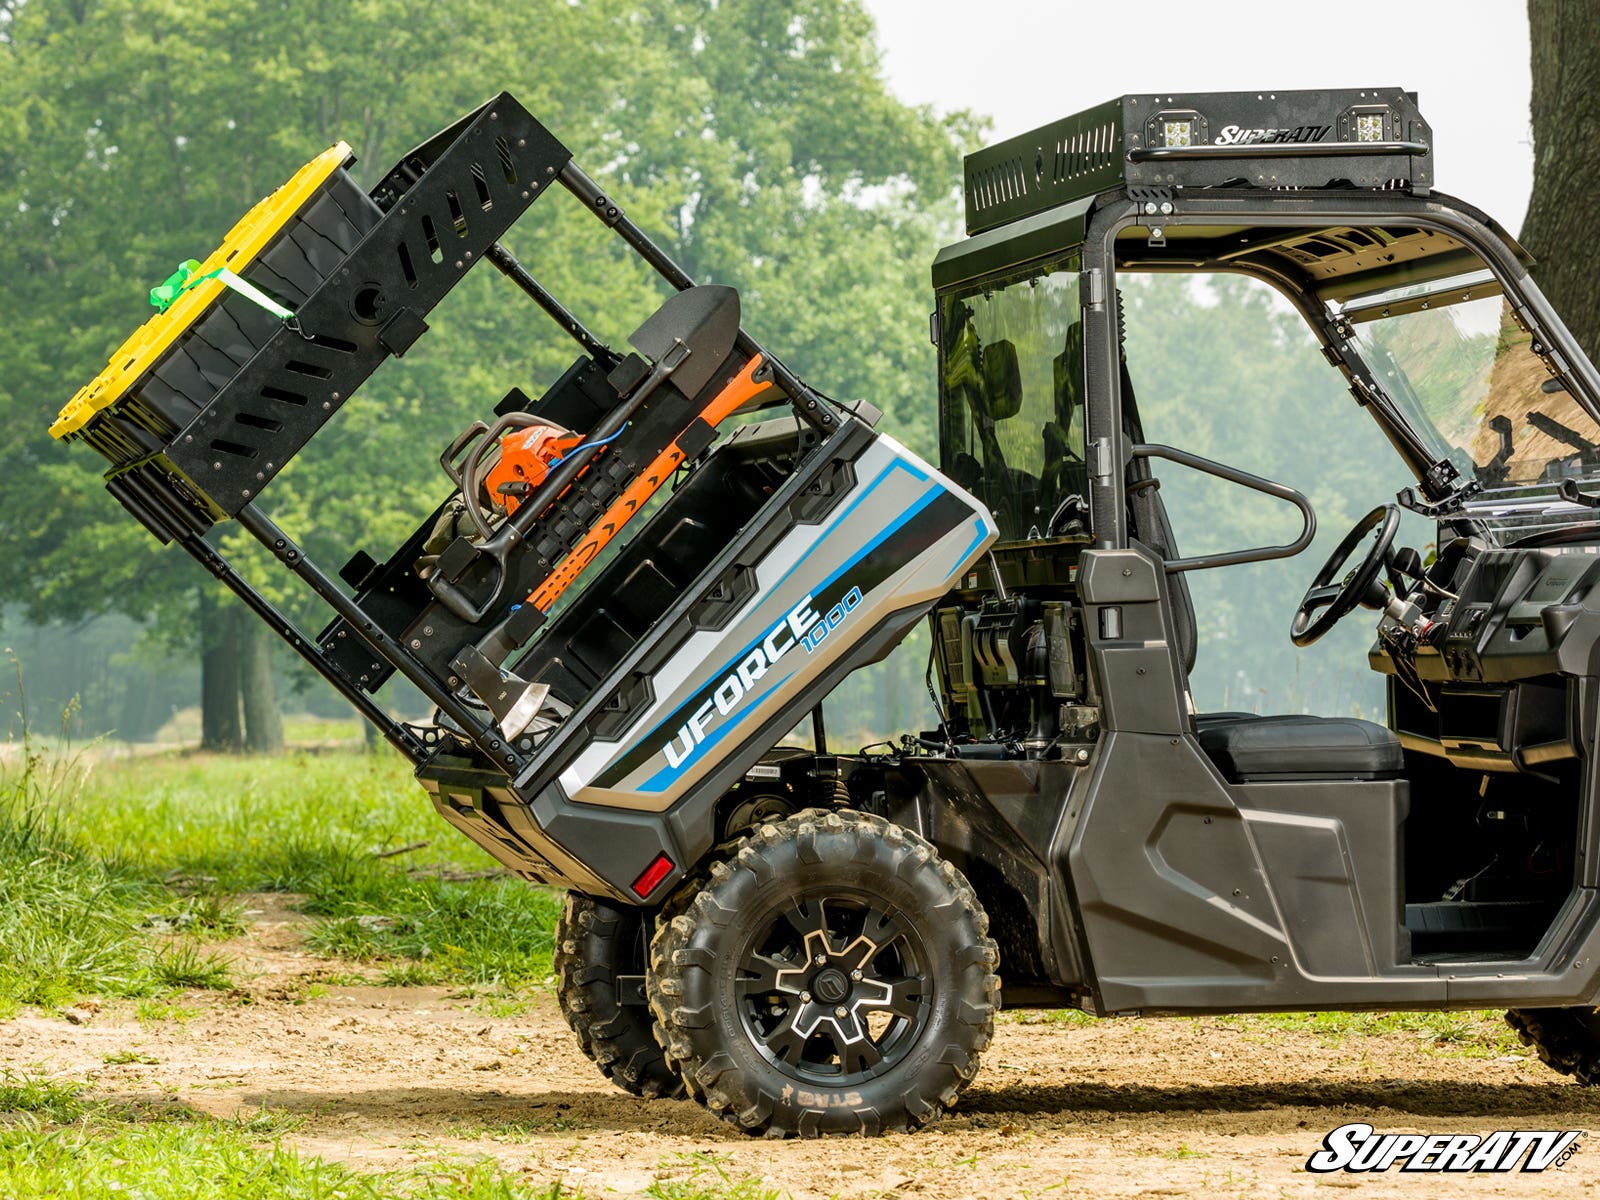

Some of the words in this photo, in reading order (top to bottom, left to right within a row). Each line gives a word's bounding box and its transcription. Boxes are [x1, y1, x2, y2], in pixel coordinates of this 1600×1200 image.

[1215, 125, 1332, 145] SUPERATV
[800, 586, 863, 654] 1000
[662, 594, 820, 769] UFORCE
[796, 1090, 864, 1108] STAG
